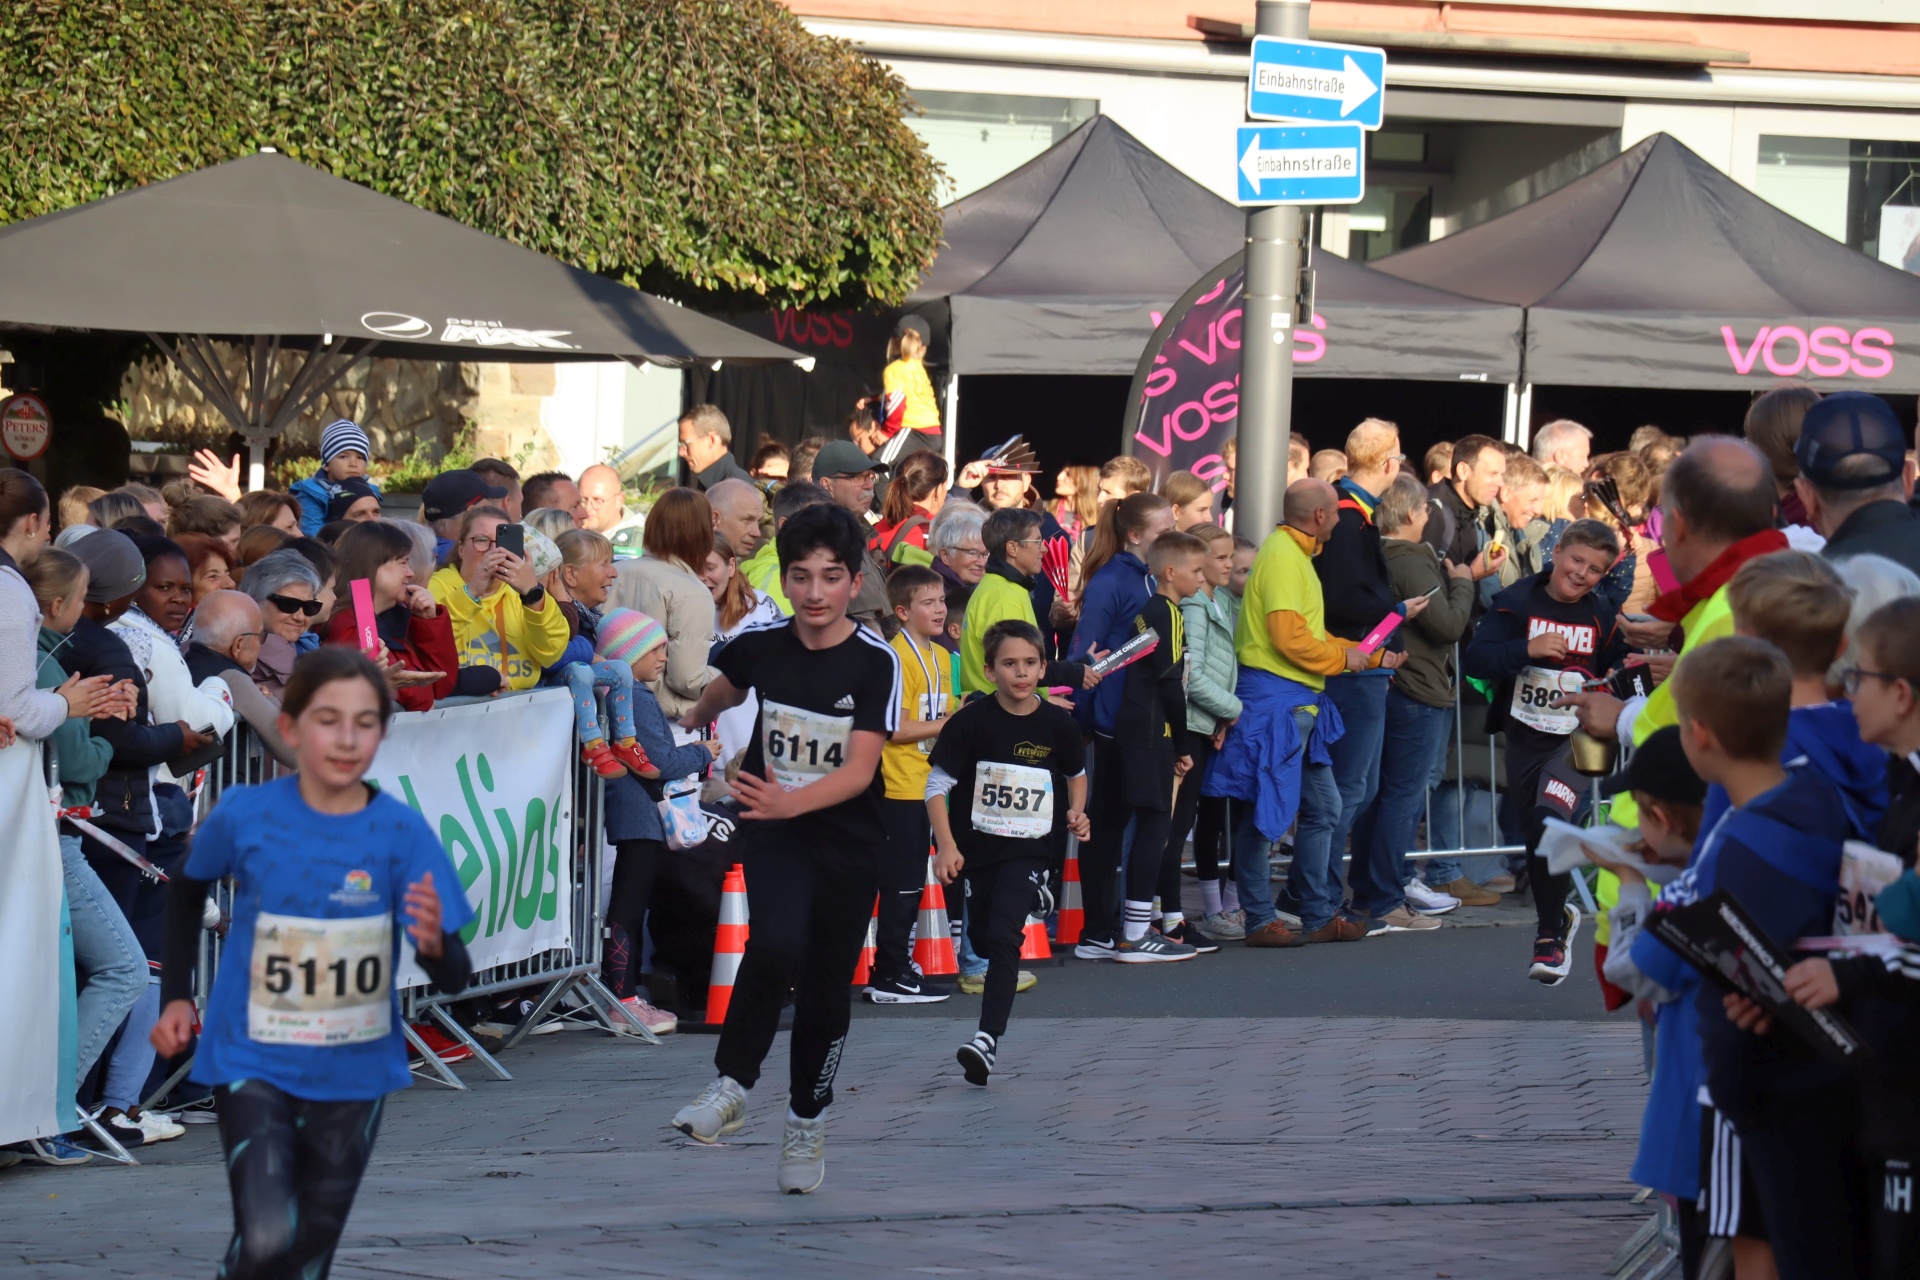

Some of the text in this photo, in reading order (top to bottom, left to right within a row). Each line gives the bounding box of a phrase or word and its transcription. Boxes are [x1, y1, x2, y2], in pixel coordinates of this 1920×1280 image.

[1259, 69, 1345, 94] Einbahnstraße
[1258, 154, 1351, 173] Einbahnstraße
[772, 306, 854, 348] VOSS
[1720, 326, 1894, 377] VOSS
[5, 421, 46, 434] PETERS
[1134, 381, 1239, 457] VOS
[1092, 658, 1108, 671] FEND
[1106, 650, 1123, 663] NEUE
[1632, 674, 1646, 697] CEN.
[769, 730, 843, 767] 6114
[982, 783, 1046, 812] 5537
[1545, 780, 1576, 810] MARVEL
[370, 752, 561, 945] elios
[265, 954, 382, 996] 5110
